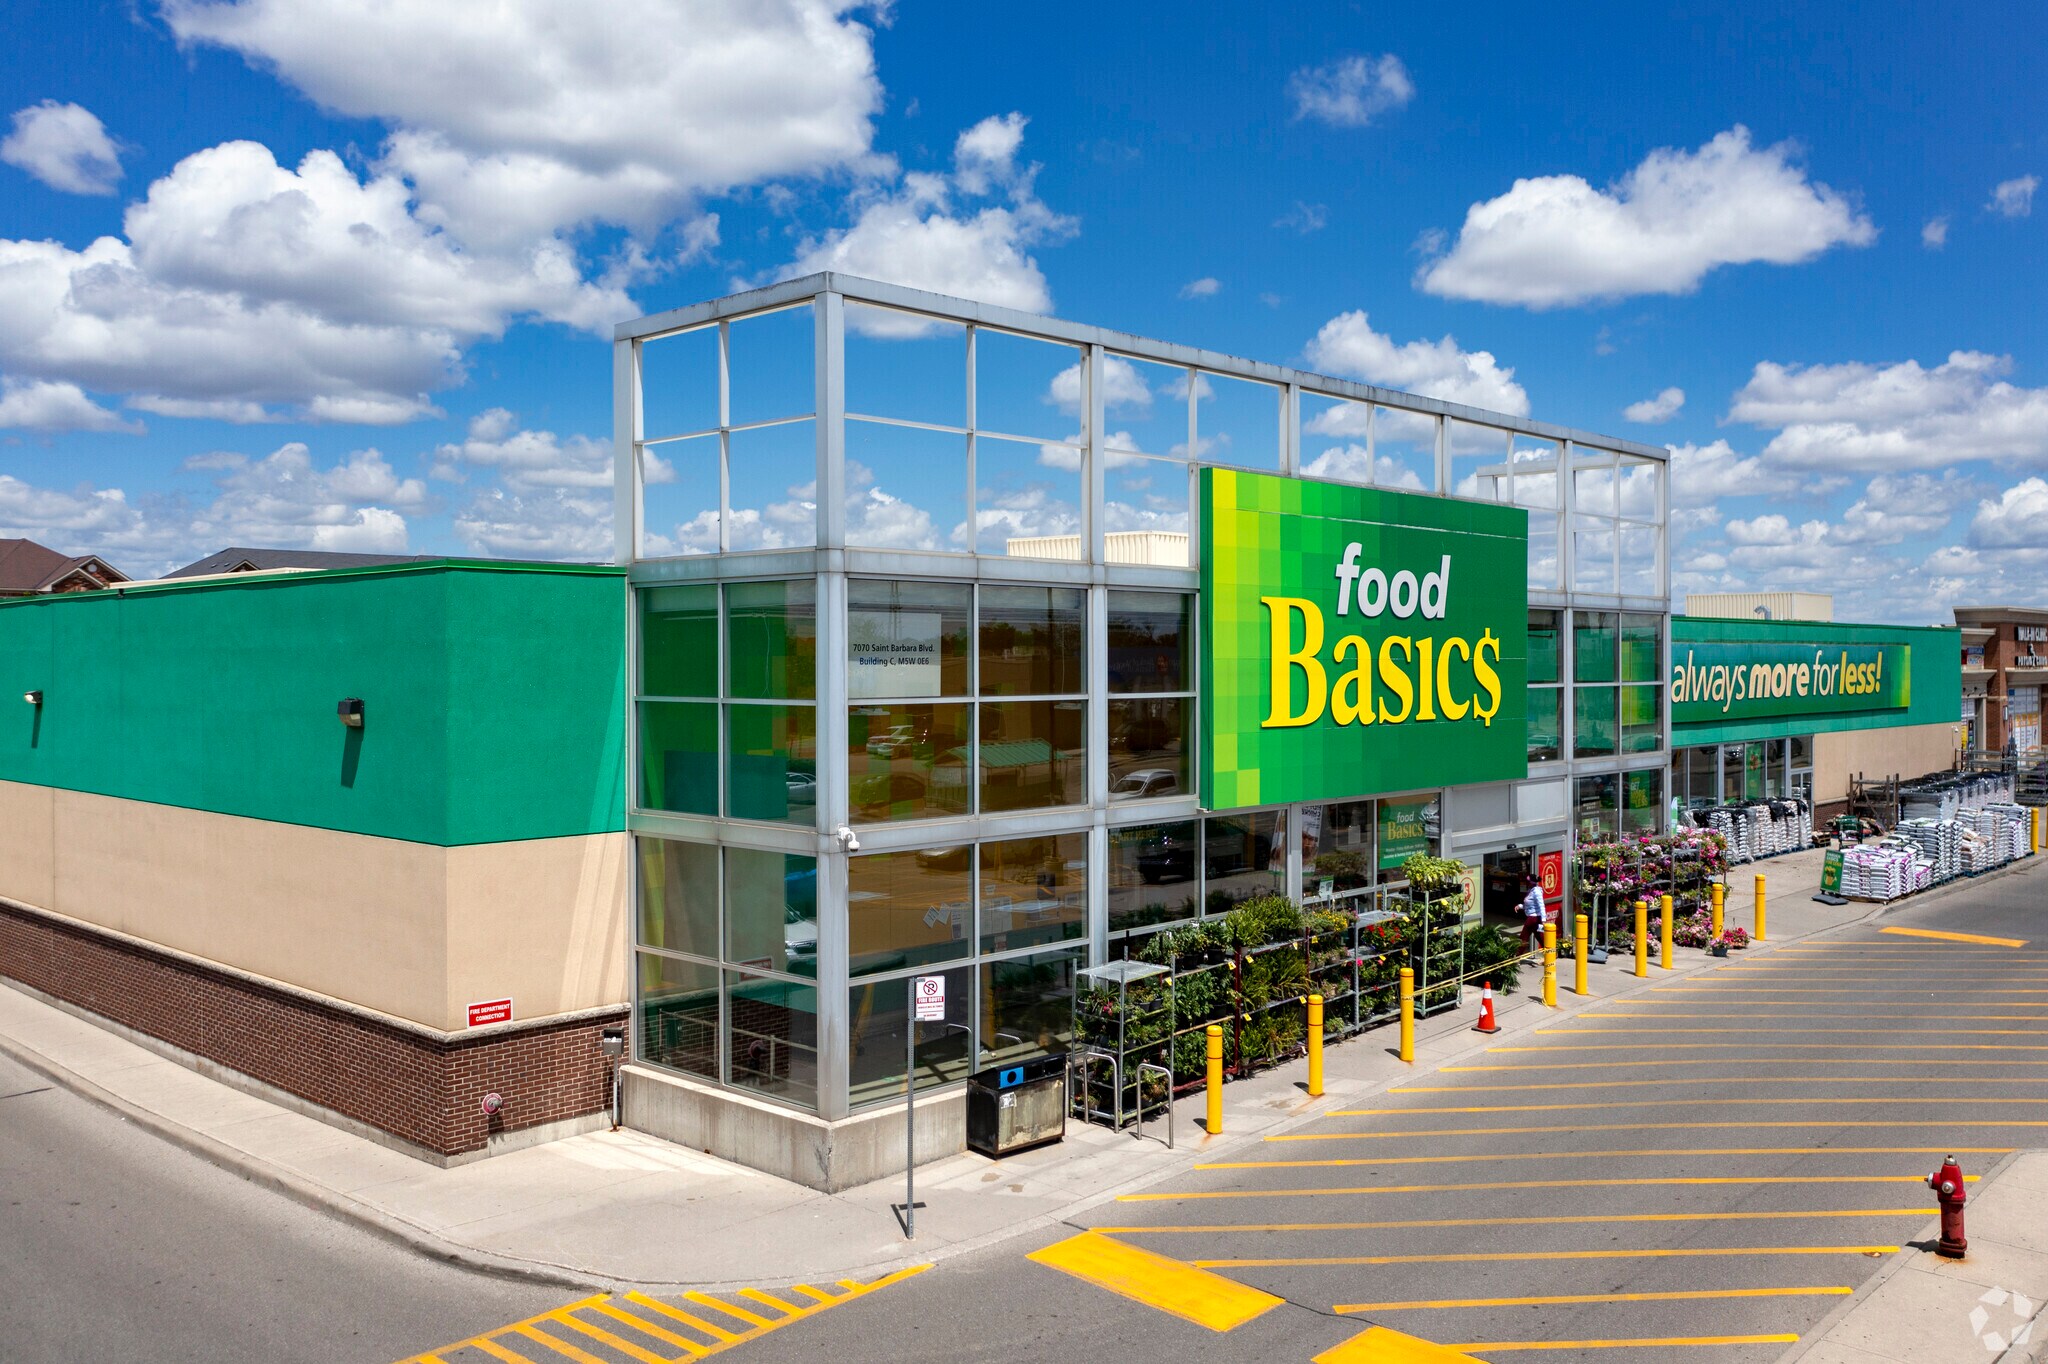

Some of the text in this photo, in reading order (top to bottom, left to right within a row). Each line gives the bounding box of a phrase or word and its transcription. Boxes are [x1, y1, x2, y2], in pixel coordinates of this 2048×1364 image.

[1335, 541, 1452, 620] food
[853, 643, 935, 652] 7070 Saint Barbara Blvd.
[859, 657, 888, 667] Building
[898, 657, 916, 666] M5W
[1670, 649, 1883, 713] always more for less!
[1396, 811, 1415, 824] food
[481, 1003, 511, 1013] DEPARTMENT
[475, 1012, 505, 1021] CONNECTION
